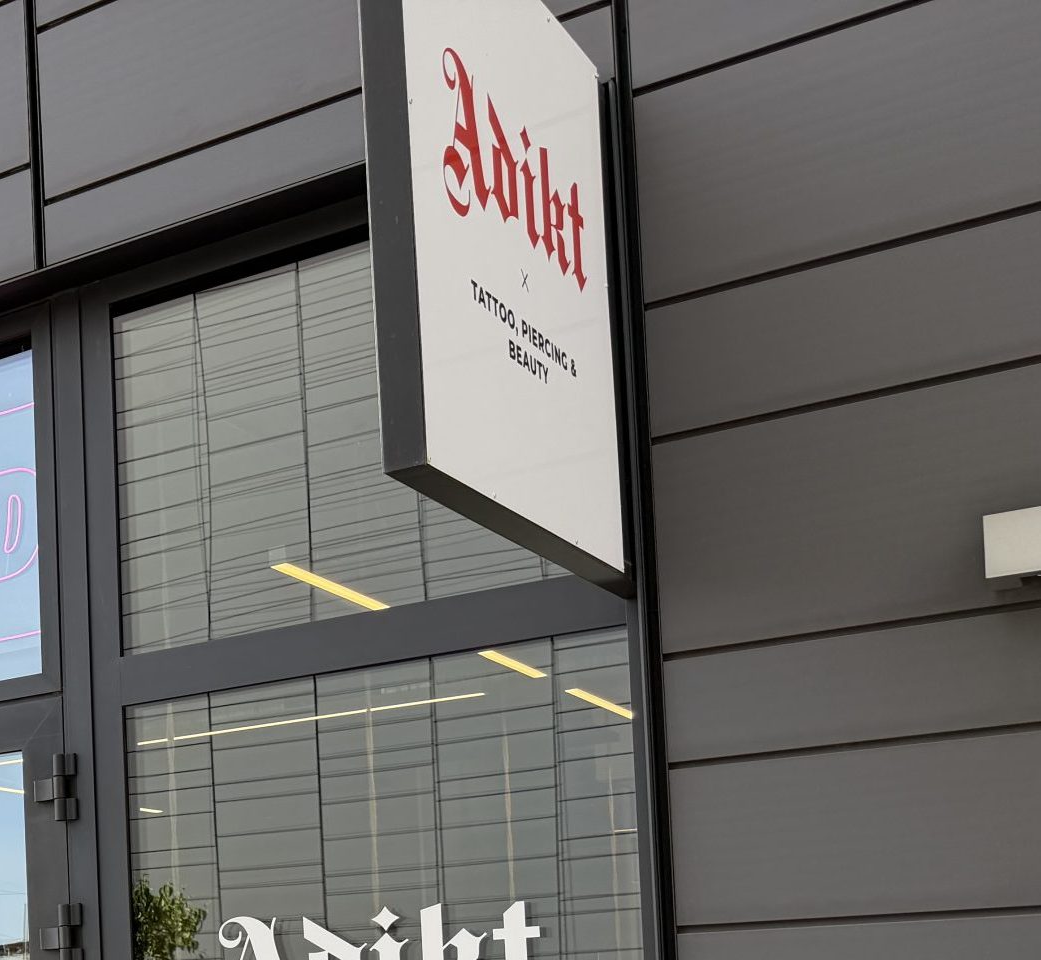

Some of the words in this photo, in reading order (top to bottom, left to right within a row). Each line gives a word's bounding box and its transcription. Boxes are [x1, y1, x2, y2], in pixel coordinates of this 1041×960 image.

[442, 47, 587, 292] Adikt
[470, 279, 519, 337] TATTOO,
[521, 319, 568, 370] PIERCING
[570, 358, 577, 377] &
[508, 339, 549, 384] BEAUTY
